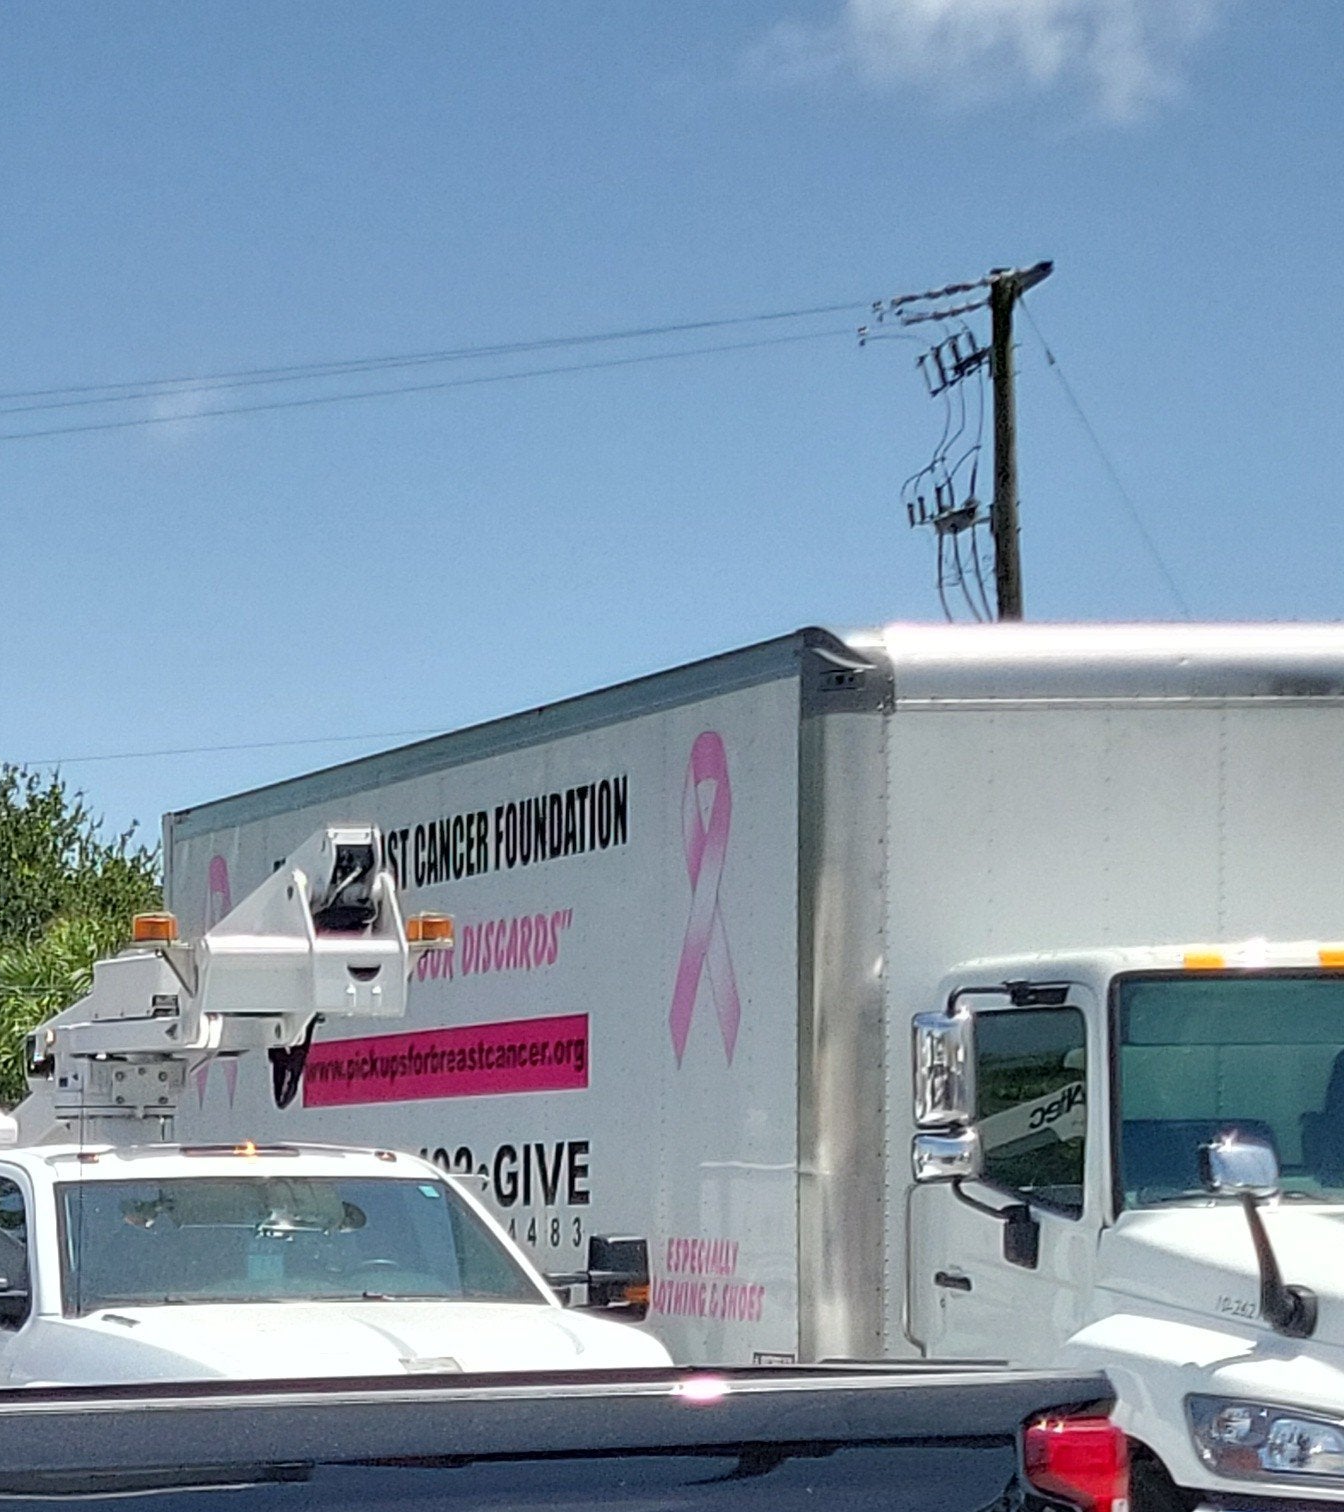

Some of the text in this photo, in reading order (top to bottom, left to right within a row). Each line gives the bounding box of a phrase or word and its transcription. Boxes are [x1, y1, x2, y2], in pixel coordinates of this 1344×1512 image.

[414, 810, 488, 888] CANCER
[493, 774, 628, 870] FOUNDATION
[461, 907, 573, 977] DISCARDS"
[721, 1283, 765, 1322] SHOES
